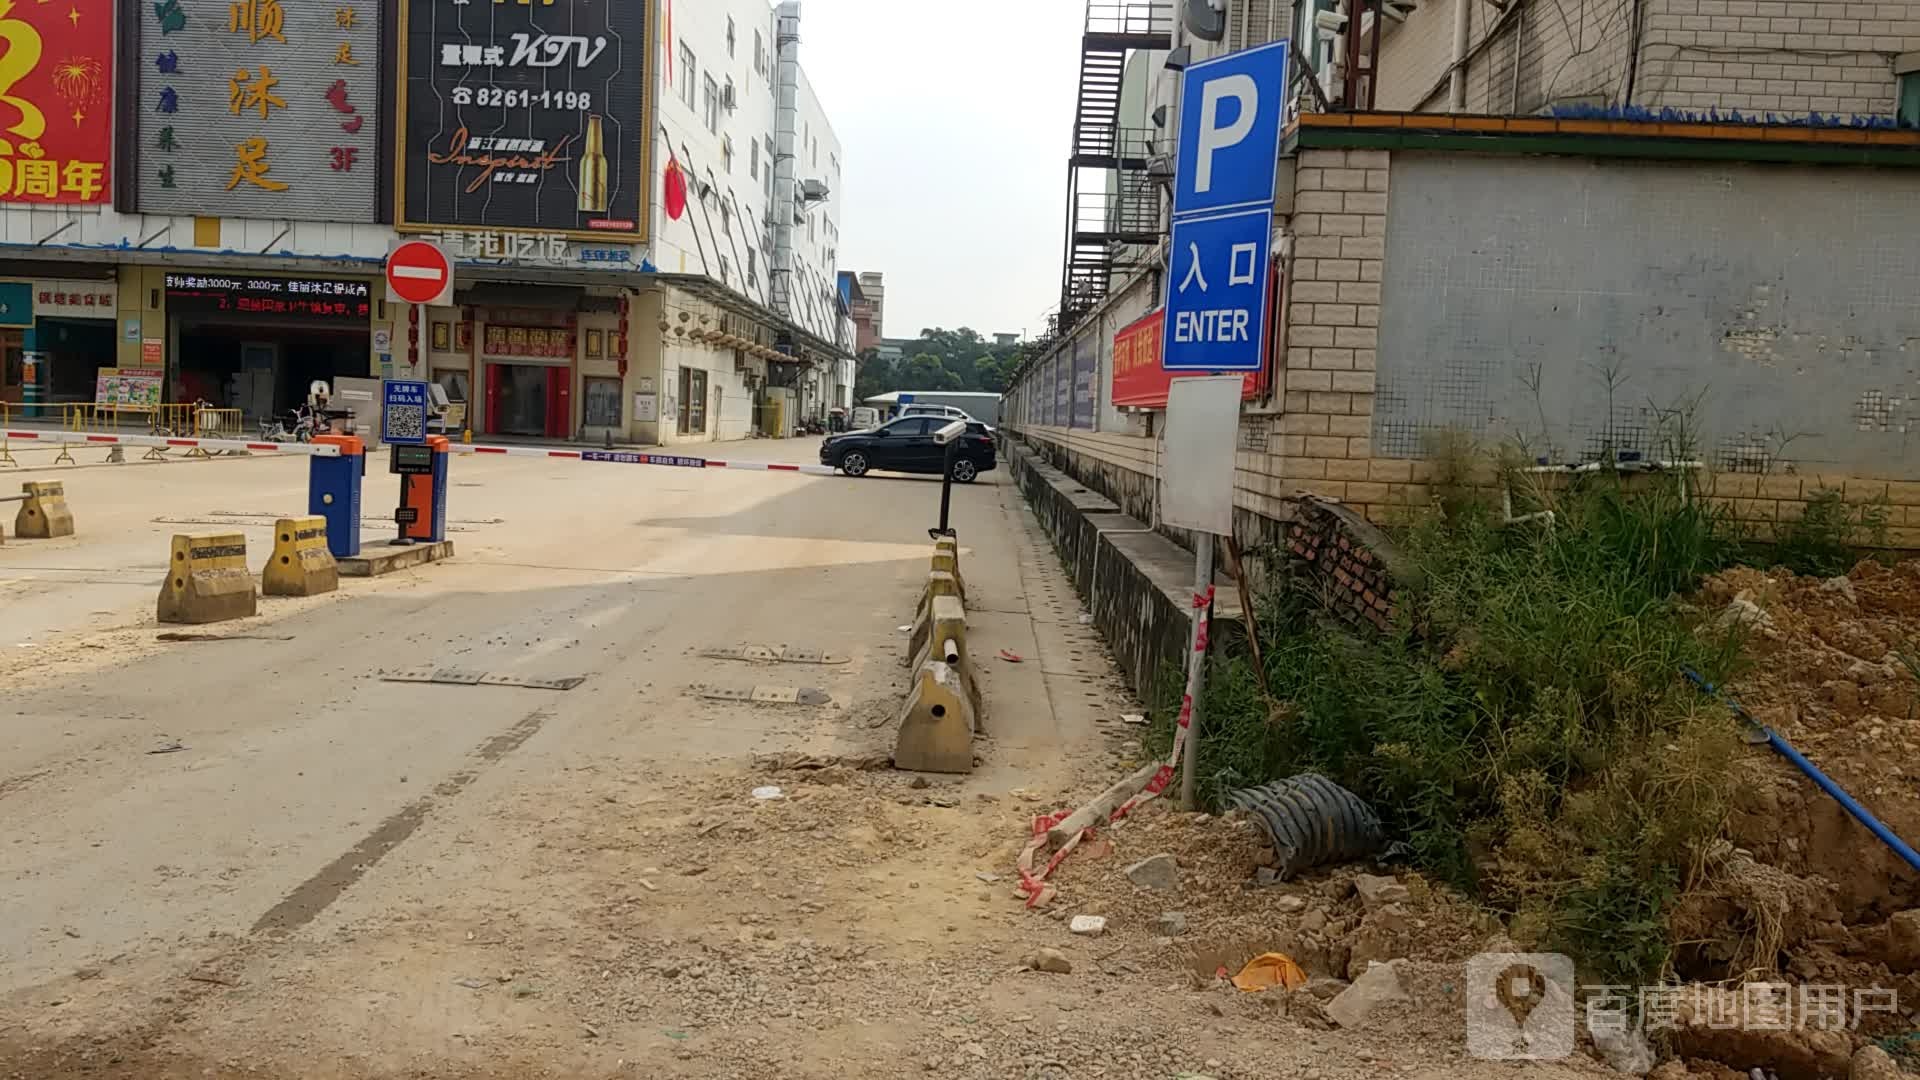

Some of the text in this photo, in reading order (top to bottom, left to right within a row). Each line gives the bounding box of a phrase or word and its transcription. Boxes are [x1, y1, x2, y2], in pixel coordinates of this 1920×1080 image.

[509, 33, 607, 68] KTV
[476, 88, 591, 111] 8261-1198
[1195, 74, 1258, 193] P
[330, 147, 358, 172] 3F
[1178, 241, 1257, 293] 入口
[1175, 309, 1249, 342] ENTER
